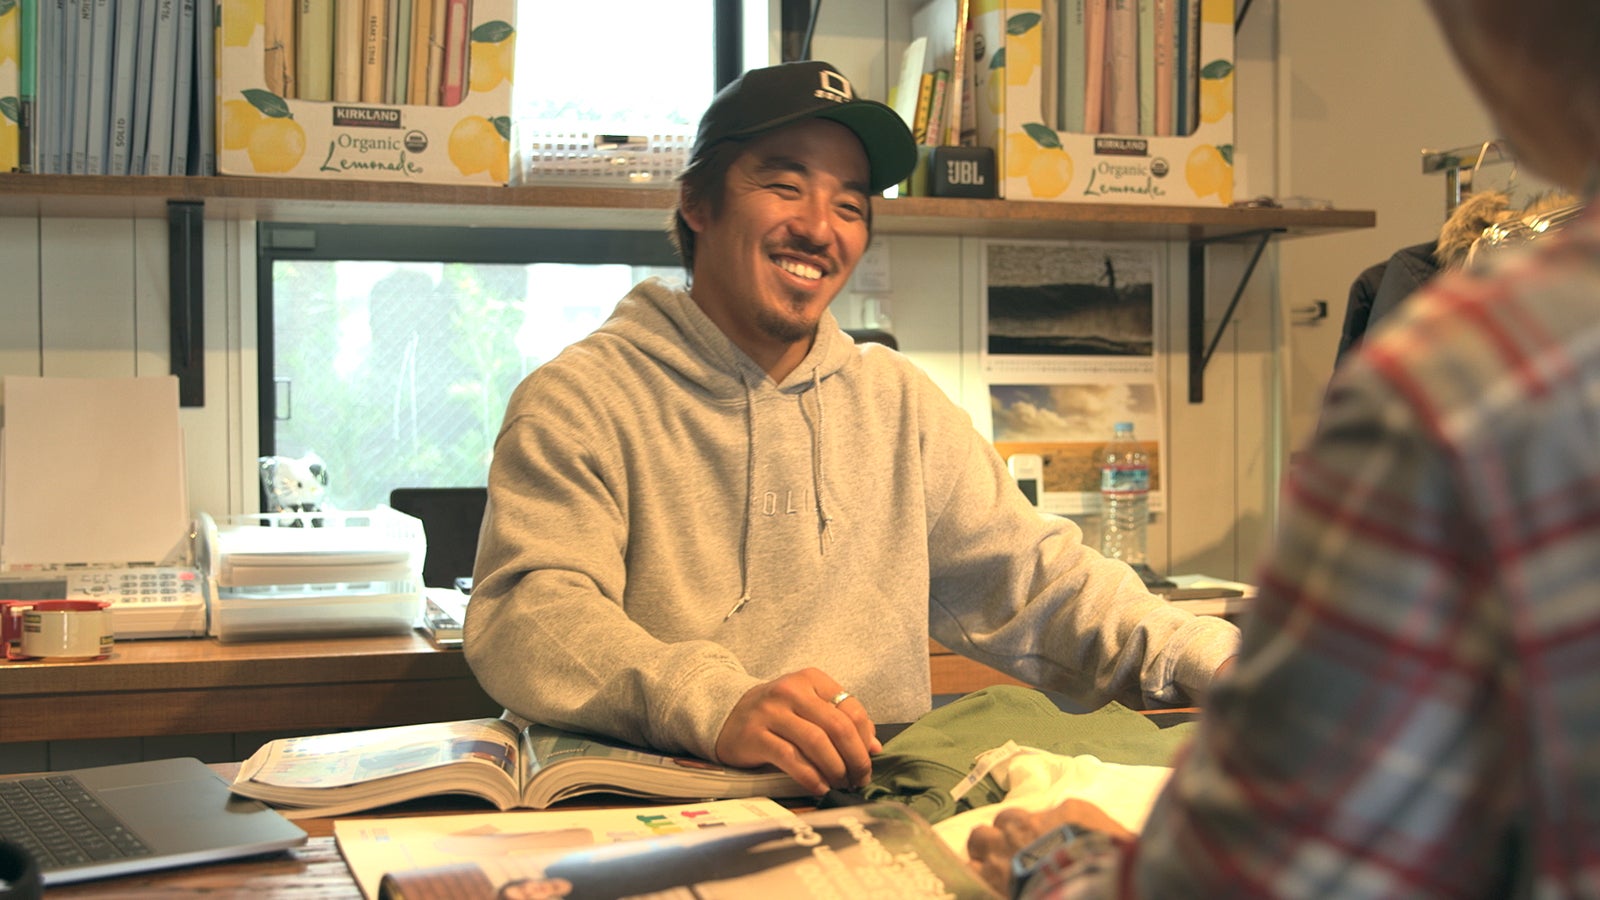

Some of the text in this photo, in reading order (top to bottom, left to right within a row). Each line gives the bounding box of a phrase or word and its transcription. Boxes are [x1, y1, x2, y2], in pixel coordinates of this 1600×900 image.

[336, 108, 398, 121] KIRKLAND
[115, 118, 126, 147] SOLID
[338, 133, 401, 153] Organic
[1097, 140, 1146, 151] KIRKLAND
[320, 140, 422, 176] Lemonade
[947, 160, 985, 185] JBL
[1099, 161, 1149, 179] Organic
[1083, 168, 1165, 199] Lemonade
